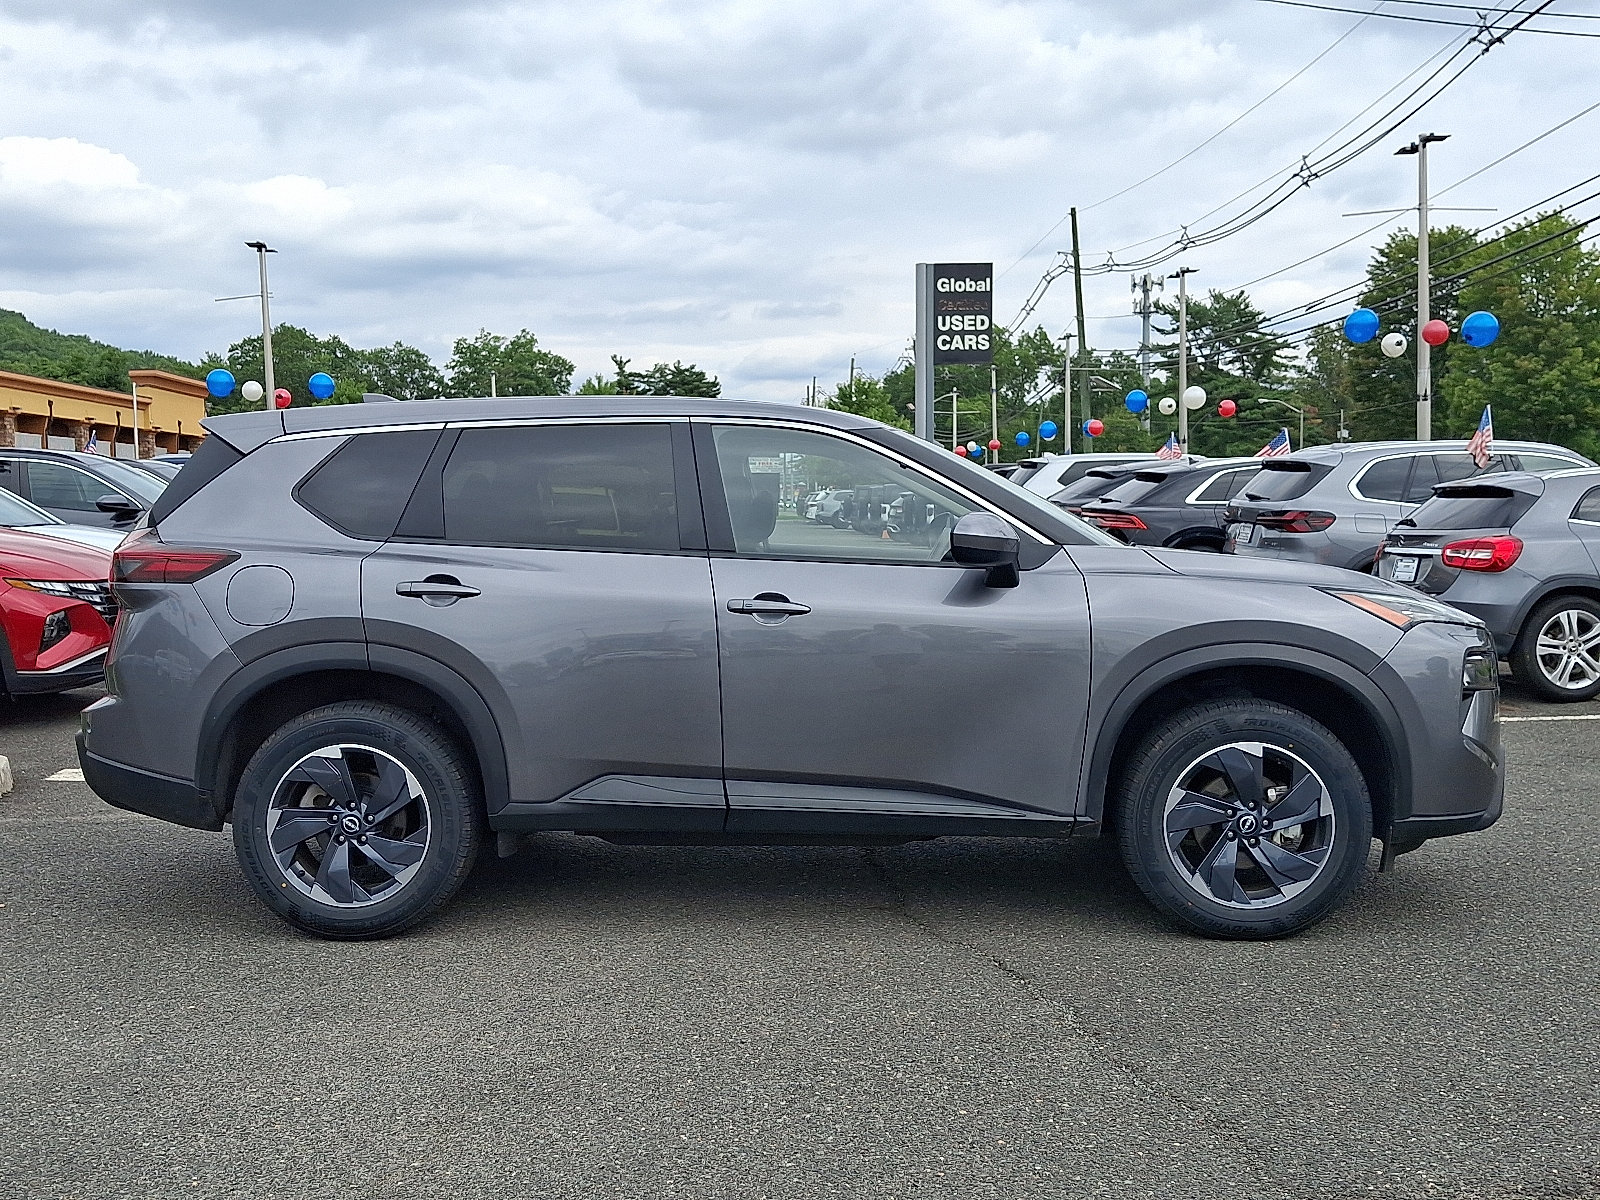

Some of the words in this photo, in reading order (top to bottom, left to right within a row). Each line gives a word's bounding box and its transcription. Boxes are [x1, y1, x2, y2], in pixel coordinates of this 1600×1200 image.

[937, 278, 991, 292] Global
[937, 315, 990, 331] USED
[937, 334, 990, 351] CARS
